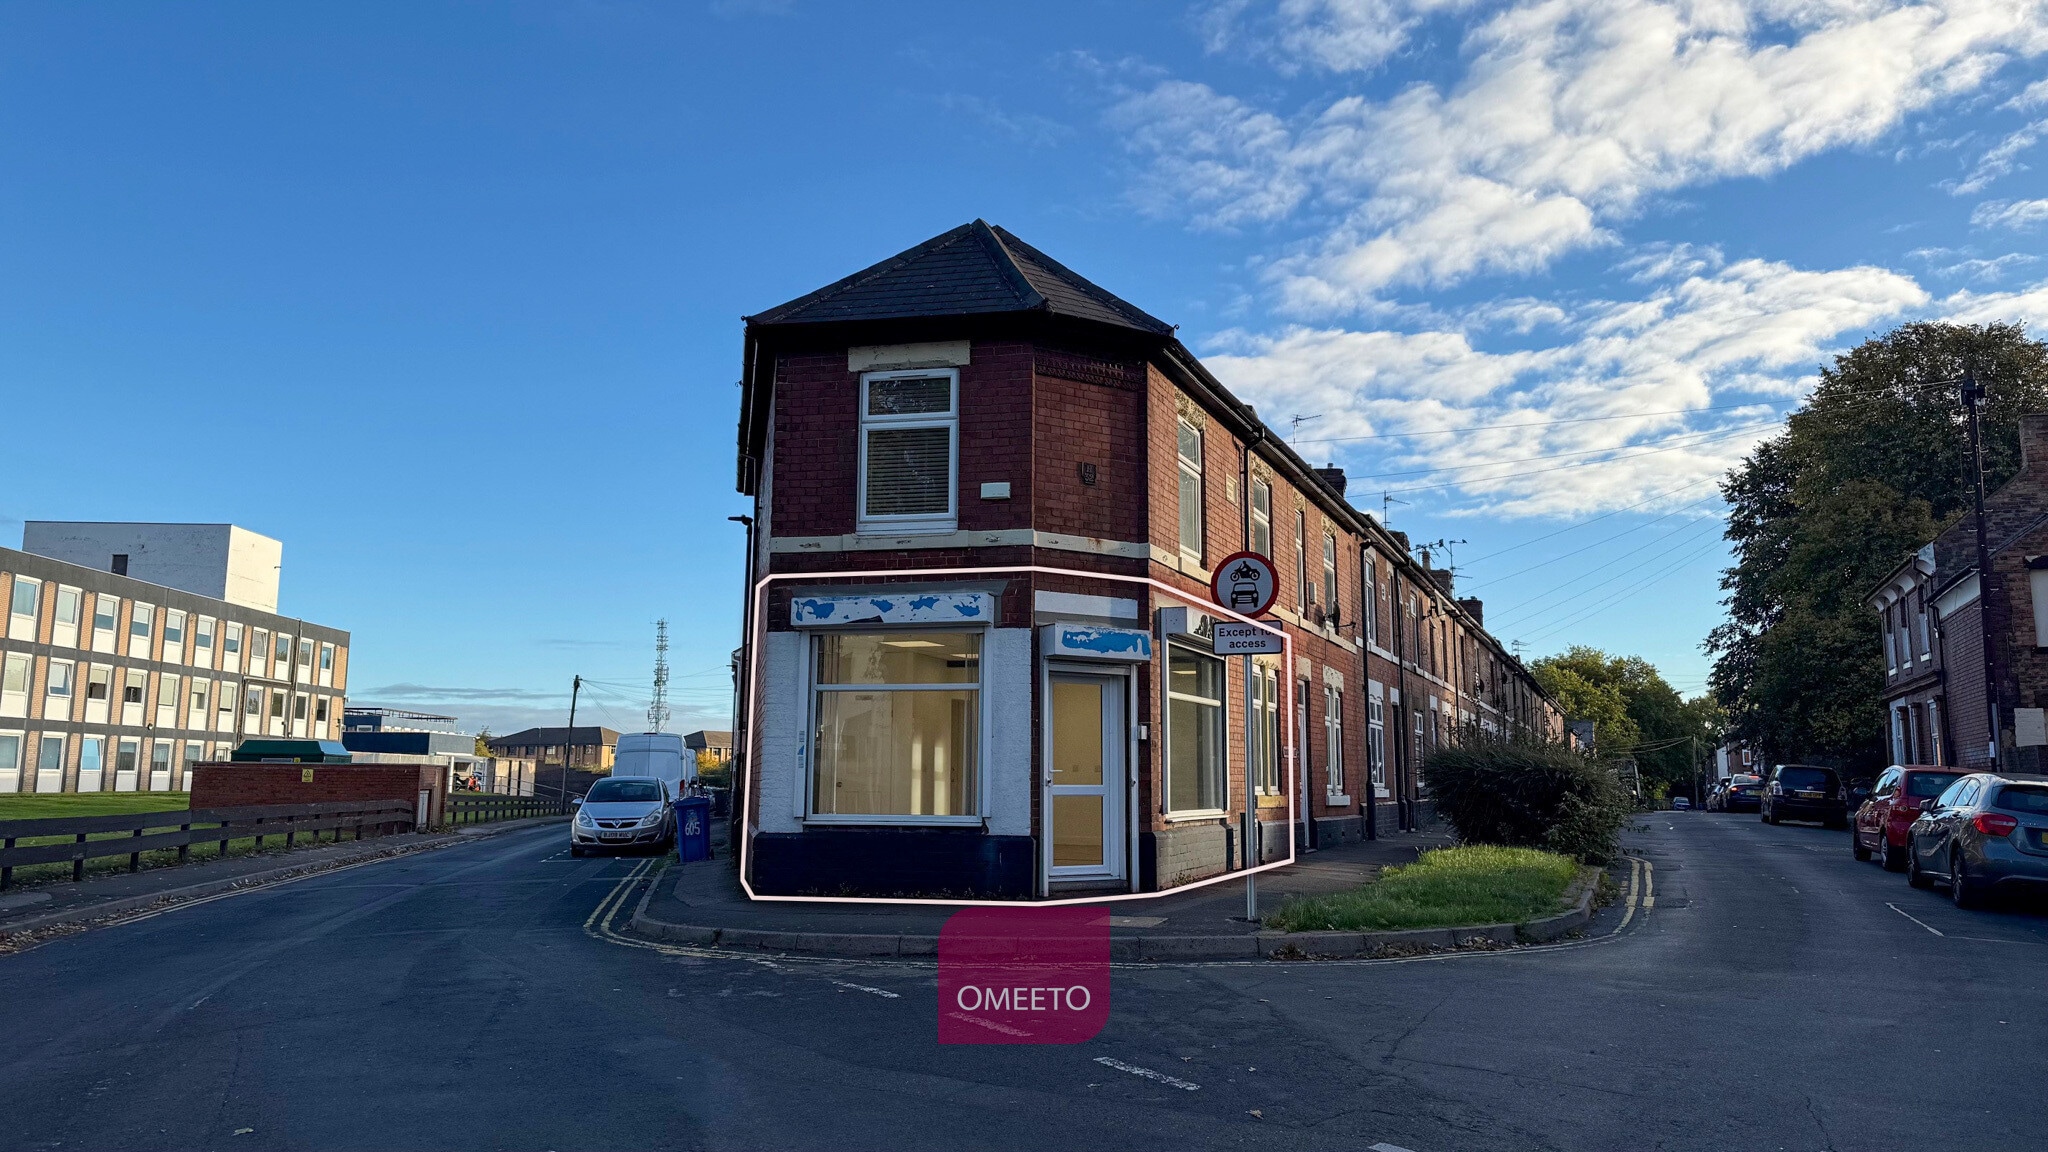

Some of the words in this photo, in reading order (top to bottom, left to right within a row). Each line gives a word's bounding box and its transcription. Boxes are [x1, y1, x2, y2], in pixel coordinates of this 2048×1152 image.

[1218, 627, 1256, 638] Except
[1261, 627, 1277, 636] fo
[1229, 640, 1266, 649] access
[685, 821, 700, 836] 605
